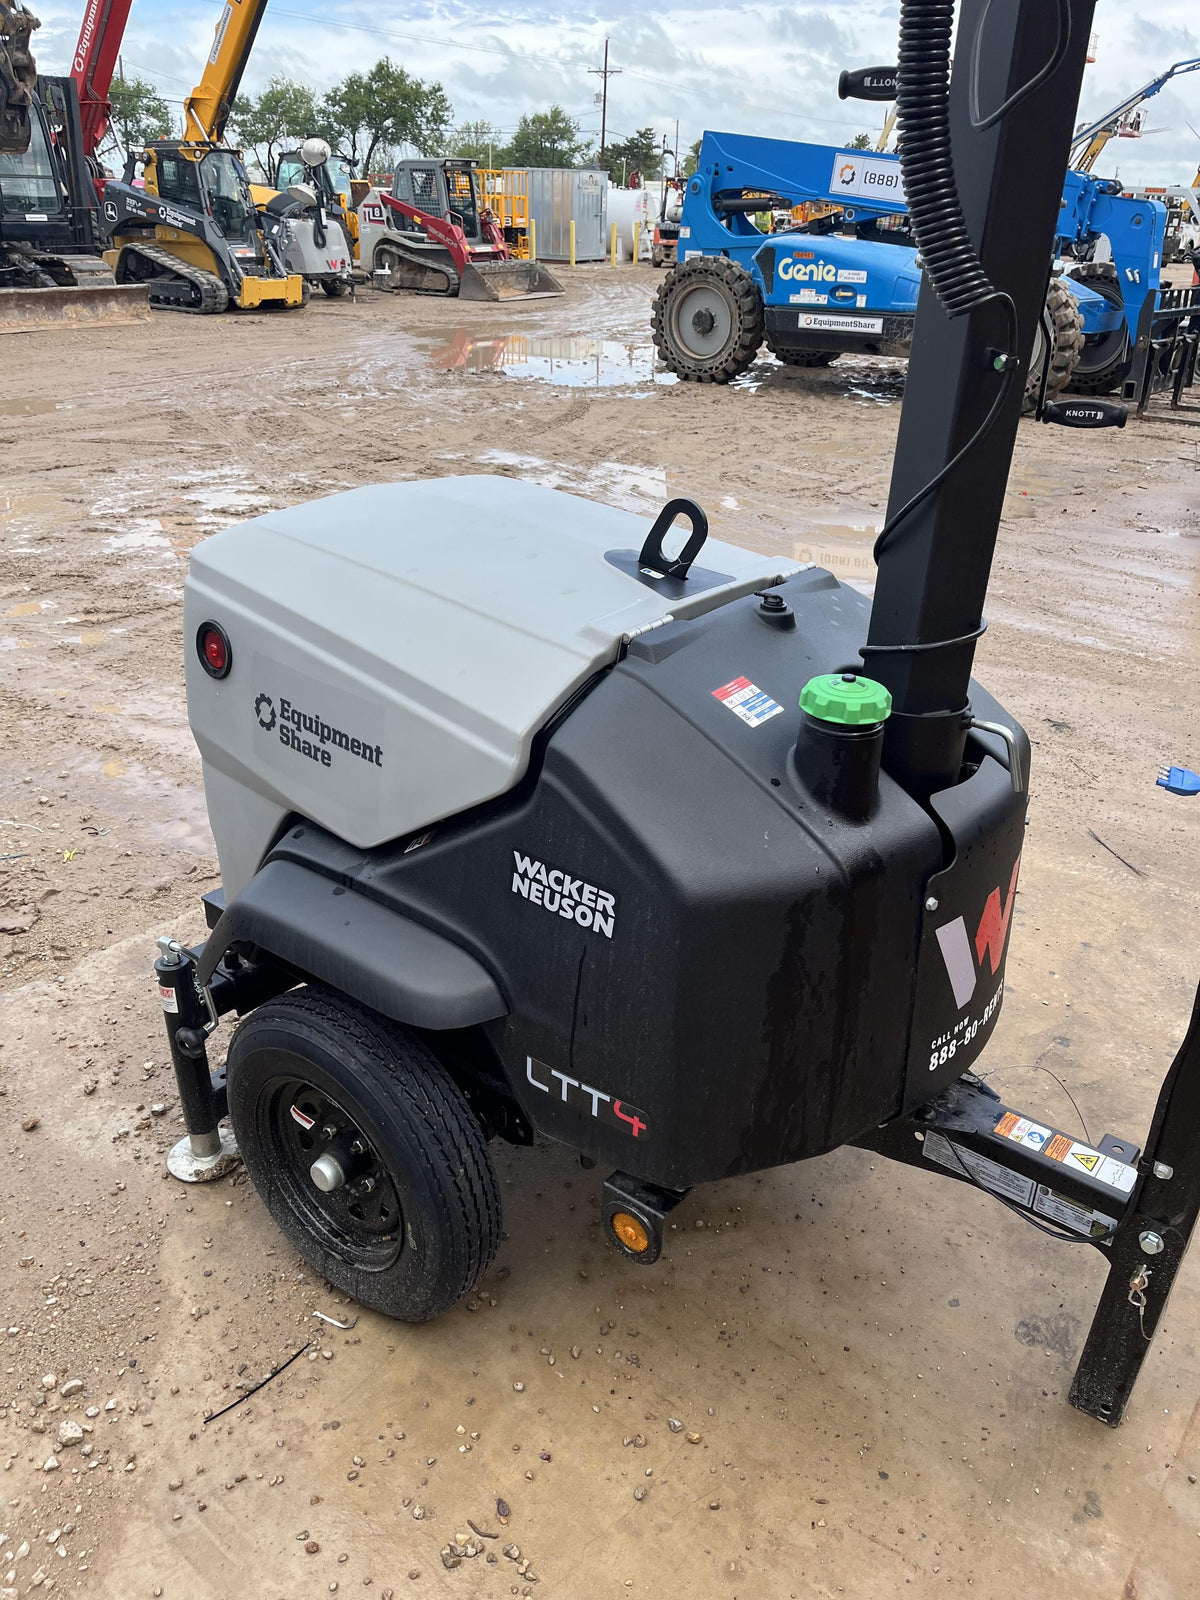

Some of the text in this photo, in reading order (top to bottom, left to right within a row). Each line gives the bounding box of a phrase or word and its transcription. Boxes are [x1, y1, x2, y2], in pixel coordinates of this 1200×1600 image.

[871, 79, 898, 87] NOTT
[864, 171, 899, 188] (888)
[778, 258, 836, 282] Genie
[813, 317, 875, 329] EquipmentShare
[1065, 409, 1097, 418] KNOTT
[279, 697, 383, 768] Equipment
[279, 723, 332, 767] Share
[513, 850, 616, 918] WACKER
[511, 872, 615, 939] NEUSON
[931, 1016, 970, 1049] CALL NOW
[526, 1056, 647, 1138] LTT4
